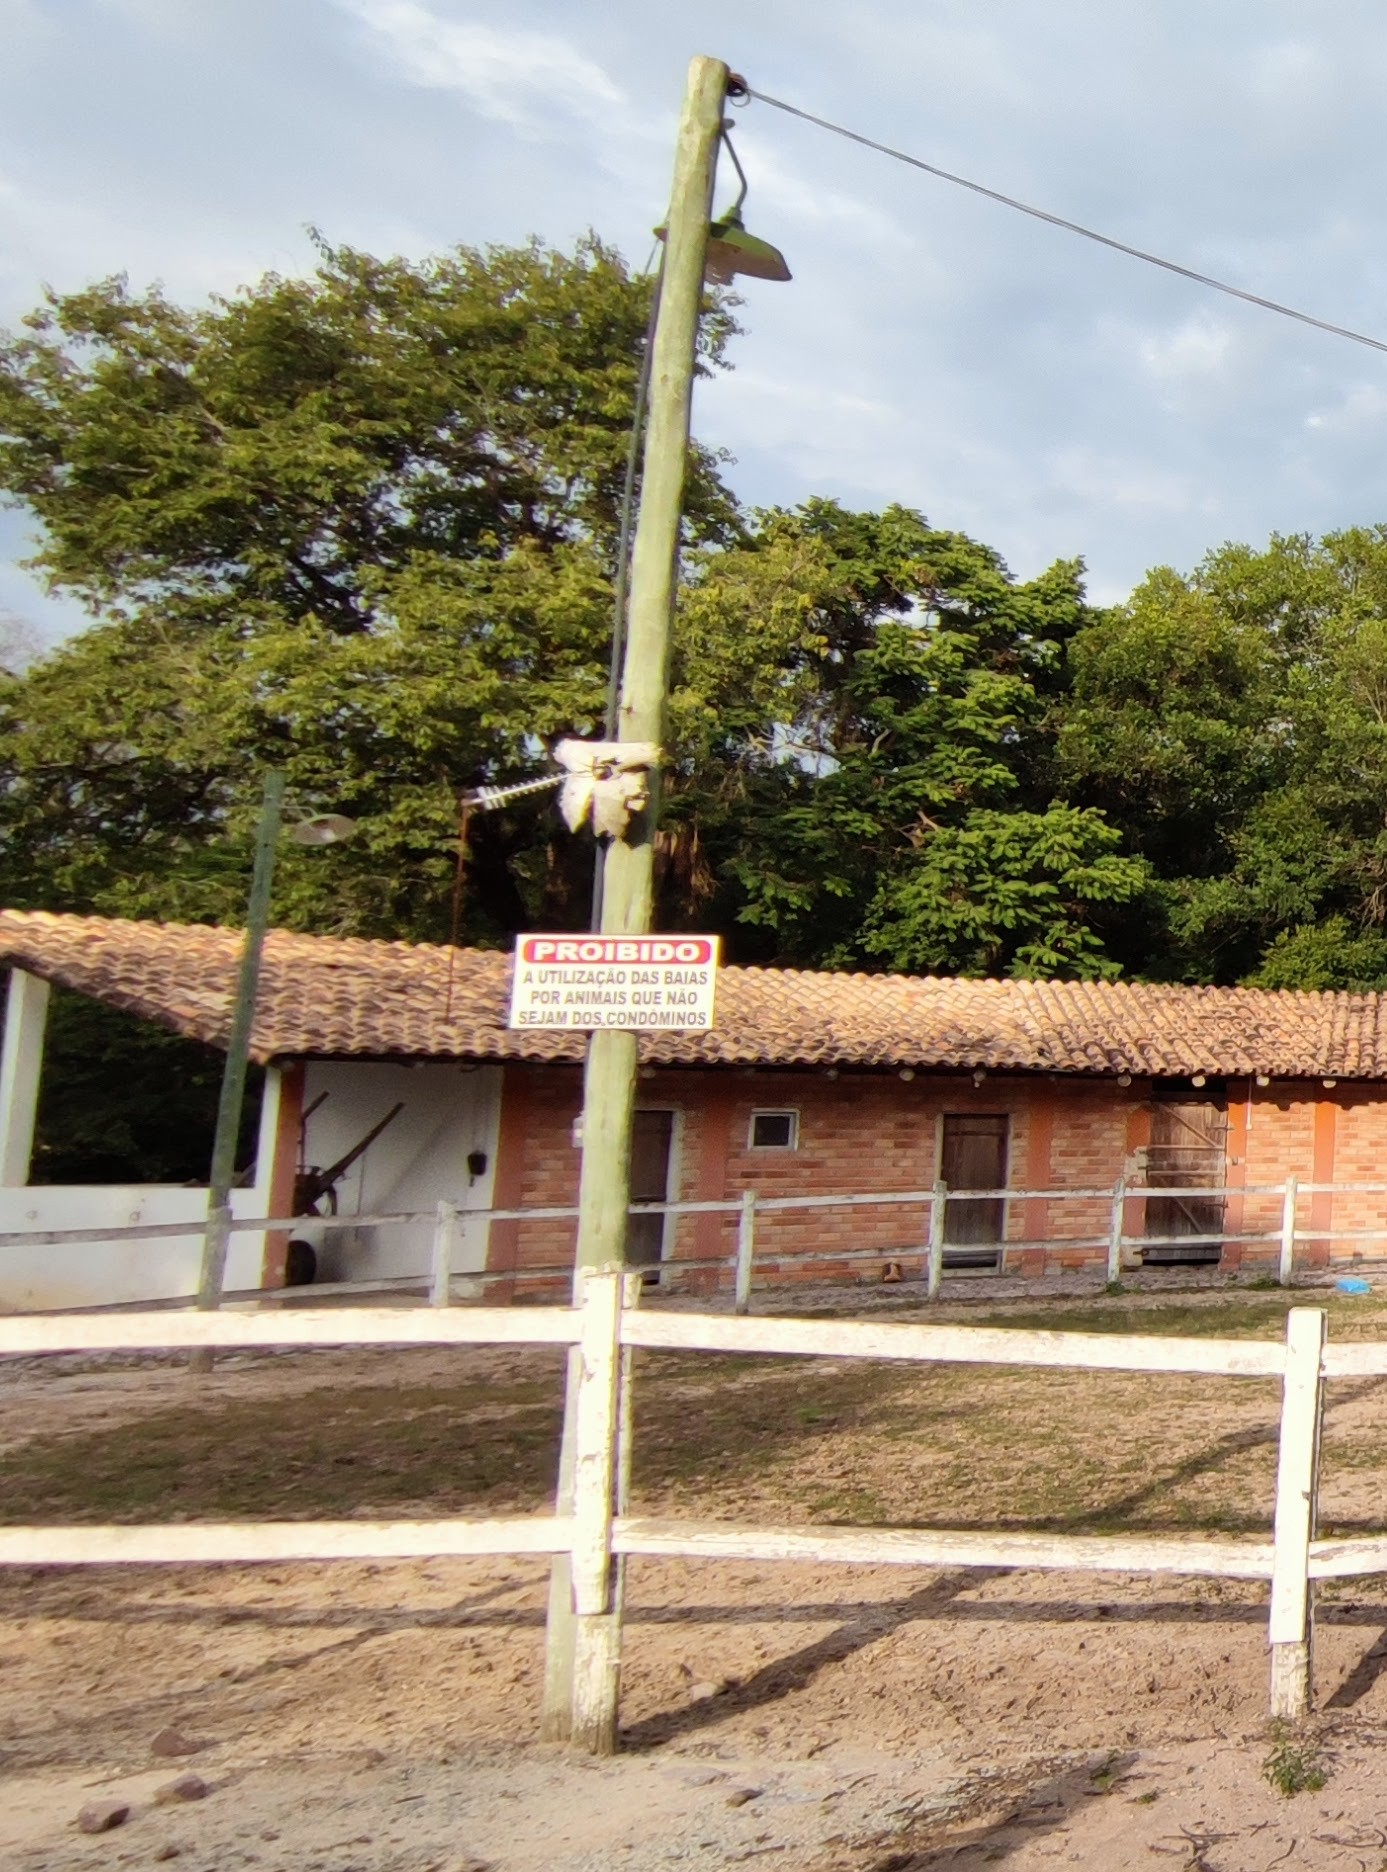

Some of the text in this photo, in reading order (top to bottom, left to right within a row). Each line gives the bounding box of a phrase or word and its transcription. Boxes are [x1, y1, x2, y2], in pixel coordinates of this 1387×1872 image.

[534, 942, 700, 962] PROIBIDO
[524, 967, 708, 988] A UTILIZAÇÃO DAS BAIAS
[531, 988, 698, 1005] POR ANIMAIS QUE NÃO
[519, 1010, 568, 1025] SEJAM
